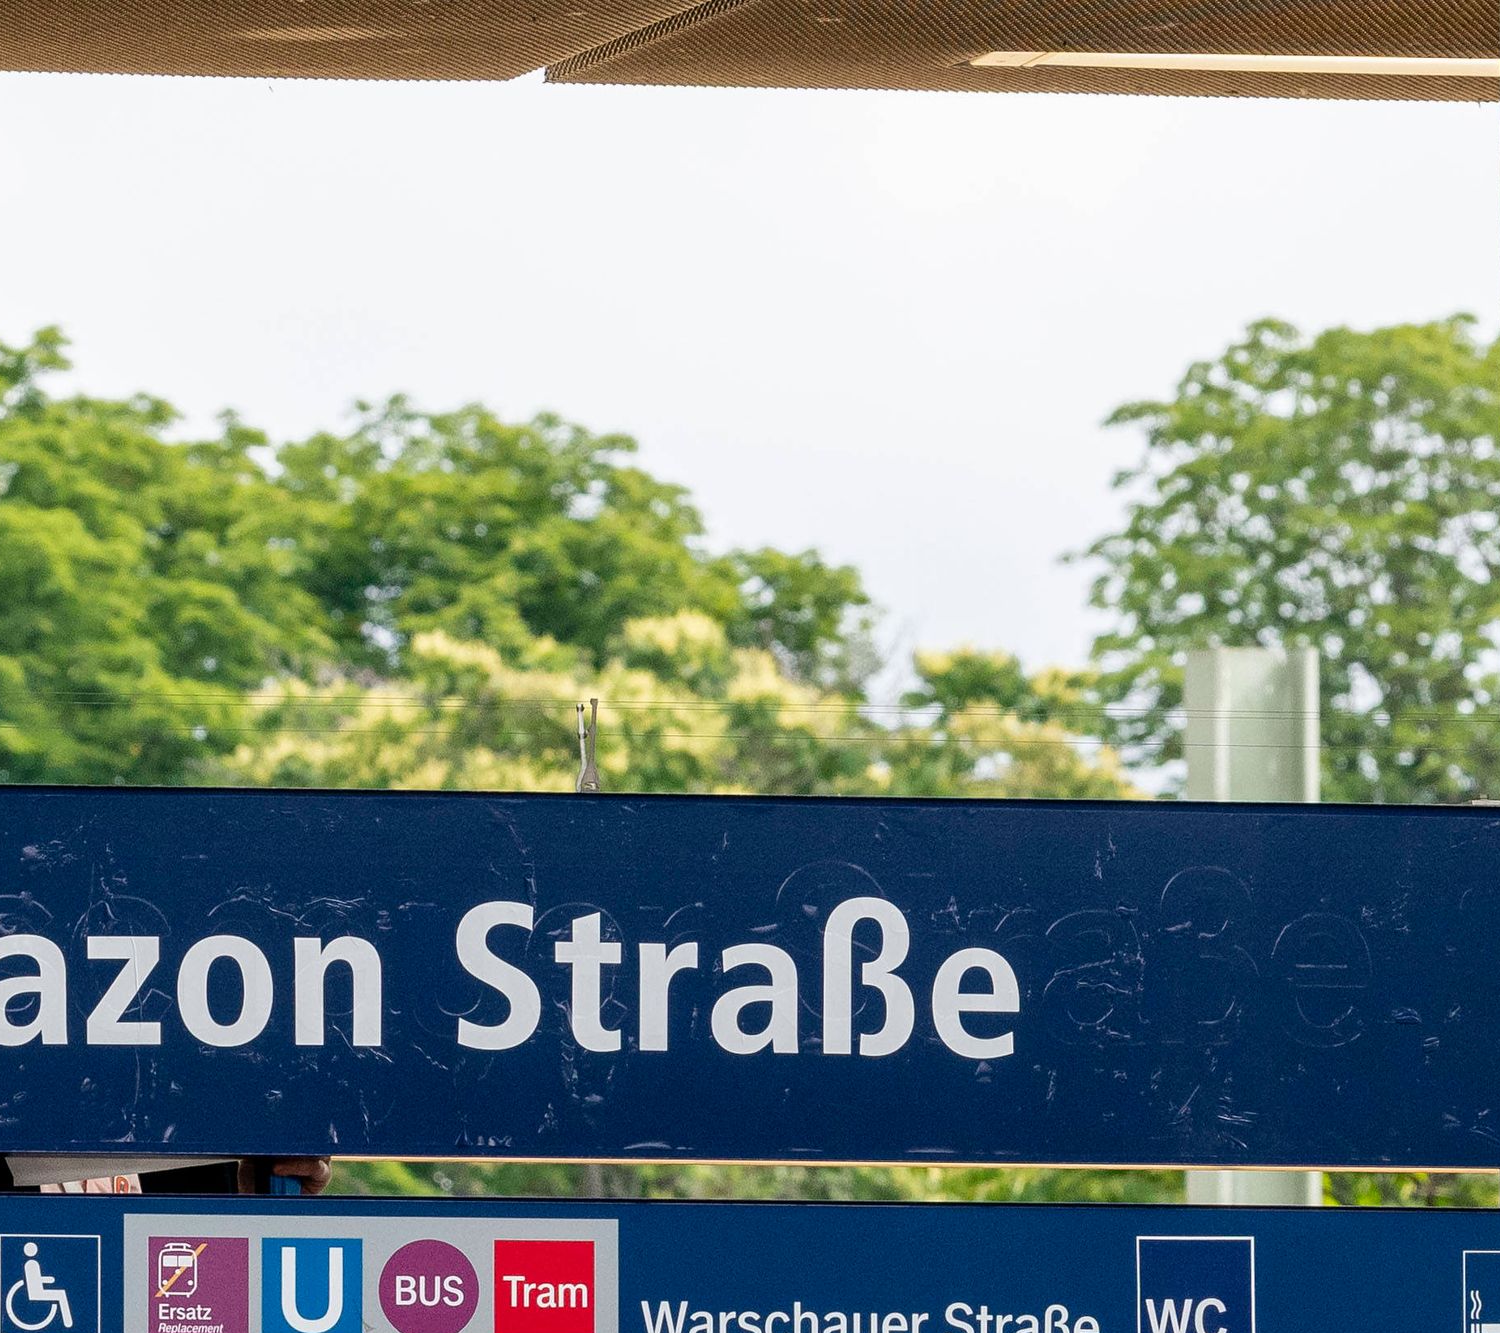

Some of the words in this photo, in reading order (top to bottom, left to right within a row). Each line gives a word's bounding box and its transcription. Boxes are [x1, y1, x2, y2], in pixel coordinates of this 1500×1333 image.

[456, 897, 1022, 1060] Straße
[396, 1276, 466, 1308] BUS
[503, 1276, 590, 1309] Tram
[157, 1303, 214, 1322] Ersatz
